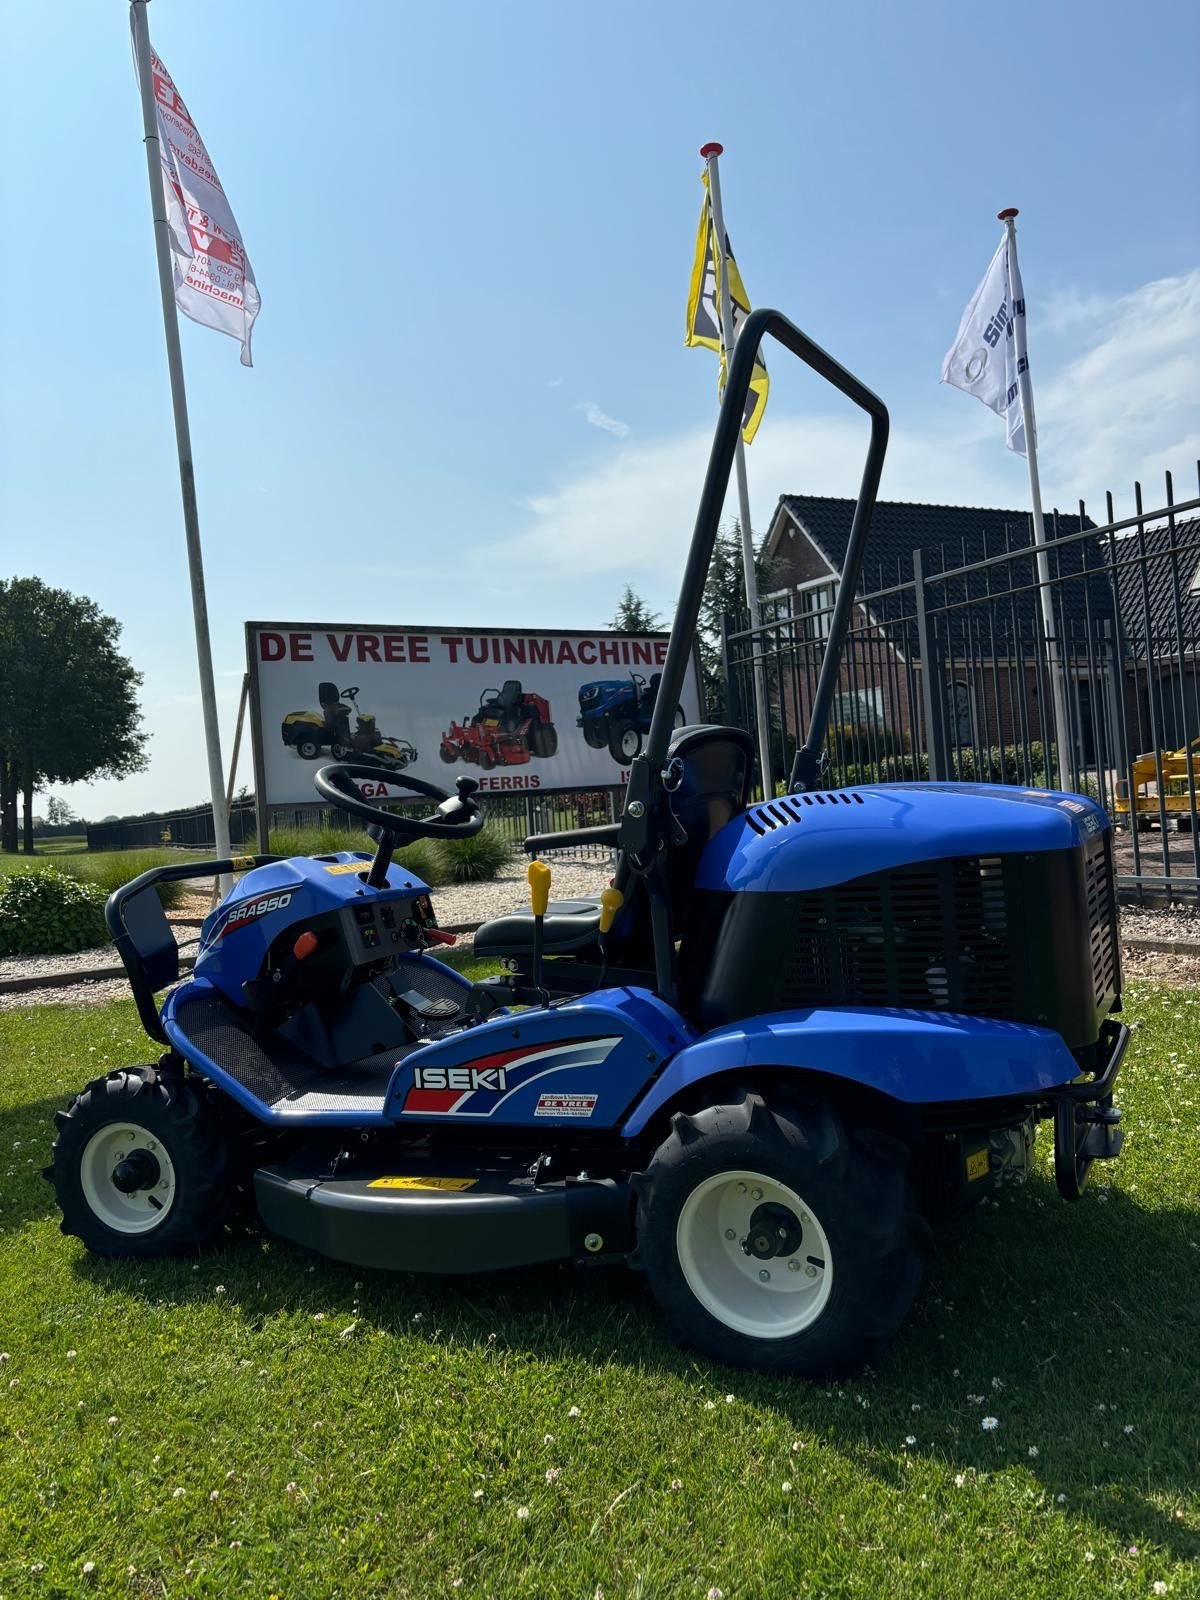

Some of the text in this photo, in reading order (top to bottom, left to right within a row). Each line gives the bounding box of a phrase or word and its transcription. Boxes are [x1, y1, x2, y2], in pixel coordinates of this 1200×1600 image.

[260, 632, 669, 666] DE VREE TUINMACHINE
[361, 782, 389, 797] GA
[479, 775, 541, 791] FERRIS
[228, 893, 292, 924] SRA950
[414, 1067, 507, 1091] ISEKI
